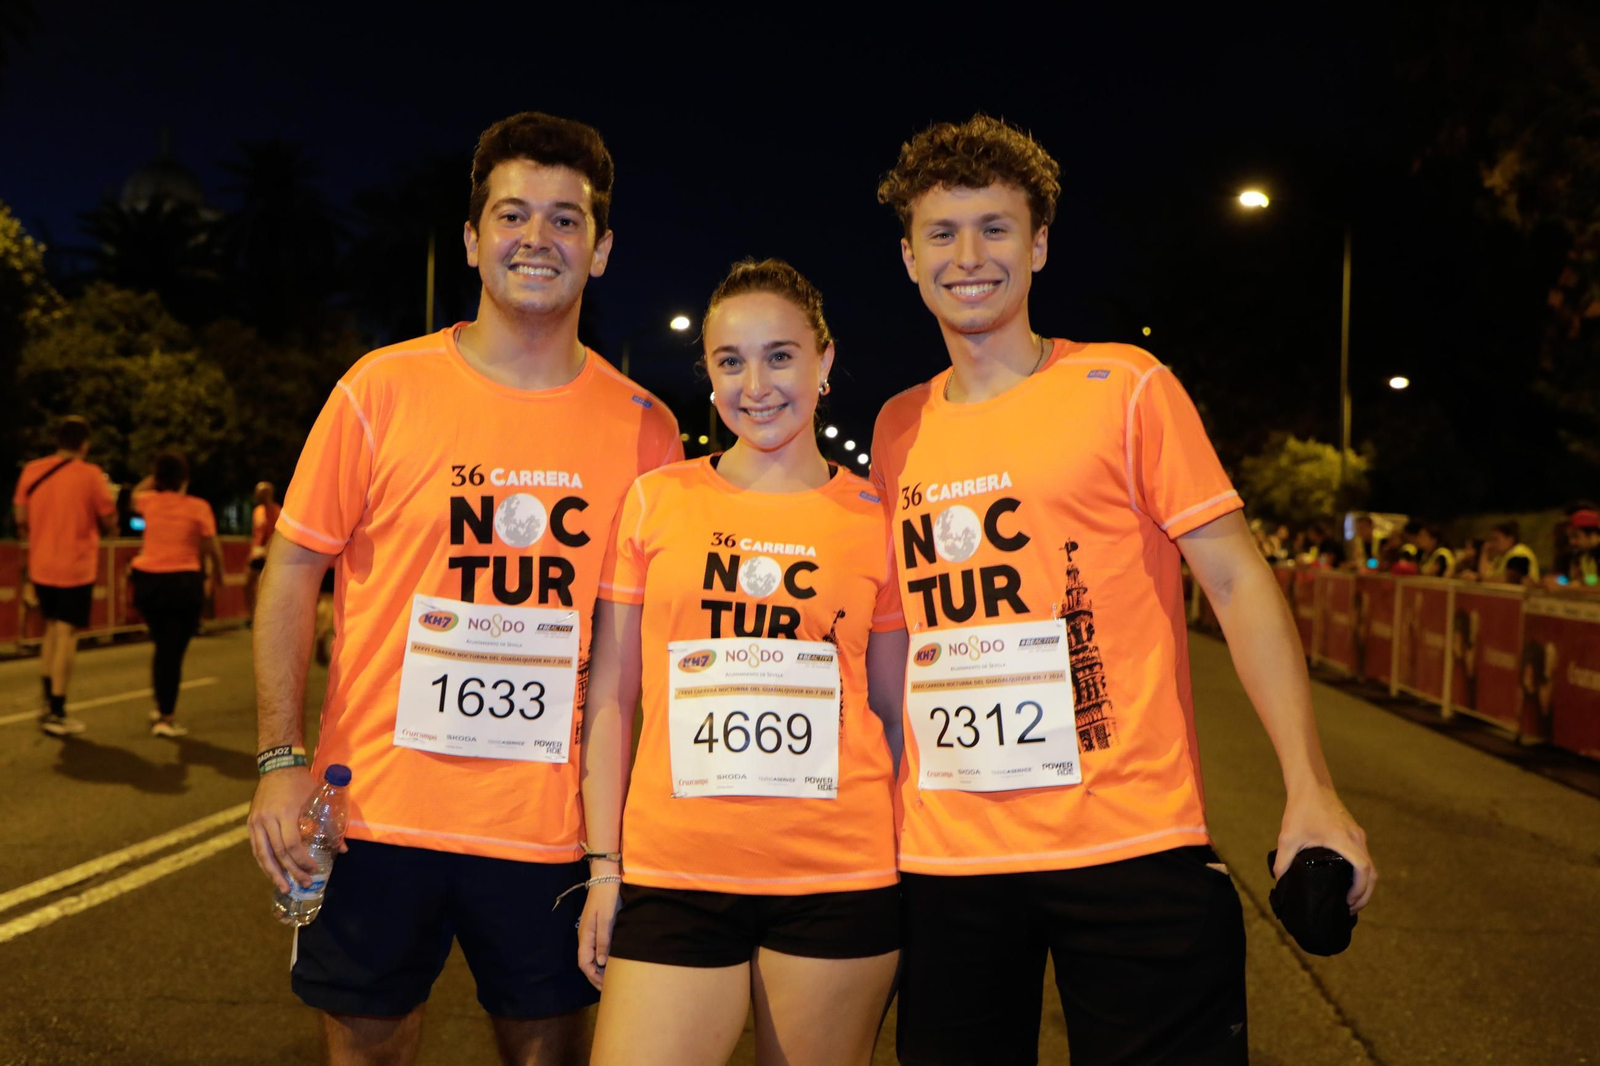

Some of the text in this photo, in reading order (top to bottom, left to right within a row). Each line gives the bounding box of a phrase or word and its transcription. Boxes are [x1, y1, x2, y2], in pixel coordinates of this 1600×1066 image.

[450, 464, 584, 489] 36 CARRERA
[901, 471, 1013, 510] 36 CARRERA
[710, 531, 817, 557] 36 CARRERA
[448, 555, 576, 607] TUR
[907, 564, 1031, 628] TUR
[701, 599, 801, 640] TUR
[431, 648, 456, 657] CARRERA
[457, 652, 488, 660] NOCTURNA
[500, 656, 542, 664] GUADALQUIVIR
[985, 676, 1032, 684] GUADALQUIVIR
[431, 673, 546, 721] 1633
[693, 710, 813, 756] 4669
[929, 700, 1046, 749] 2312
[533, 739, 563, 747] POWER
[804, 776, 833, 784] POWER
[1042, 761, 1073, 770] POWER
